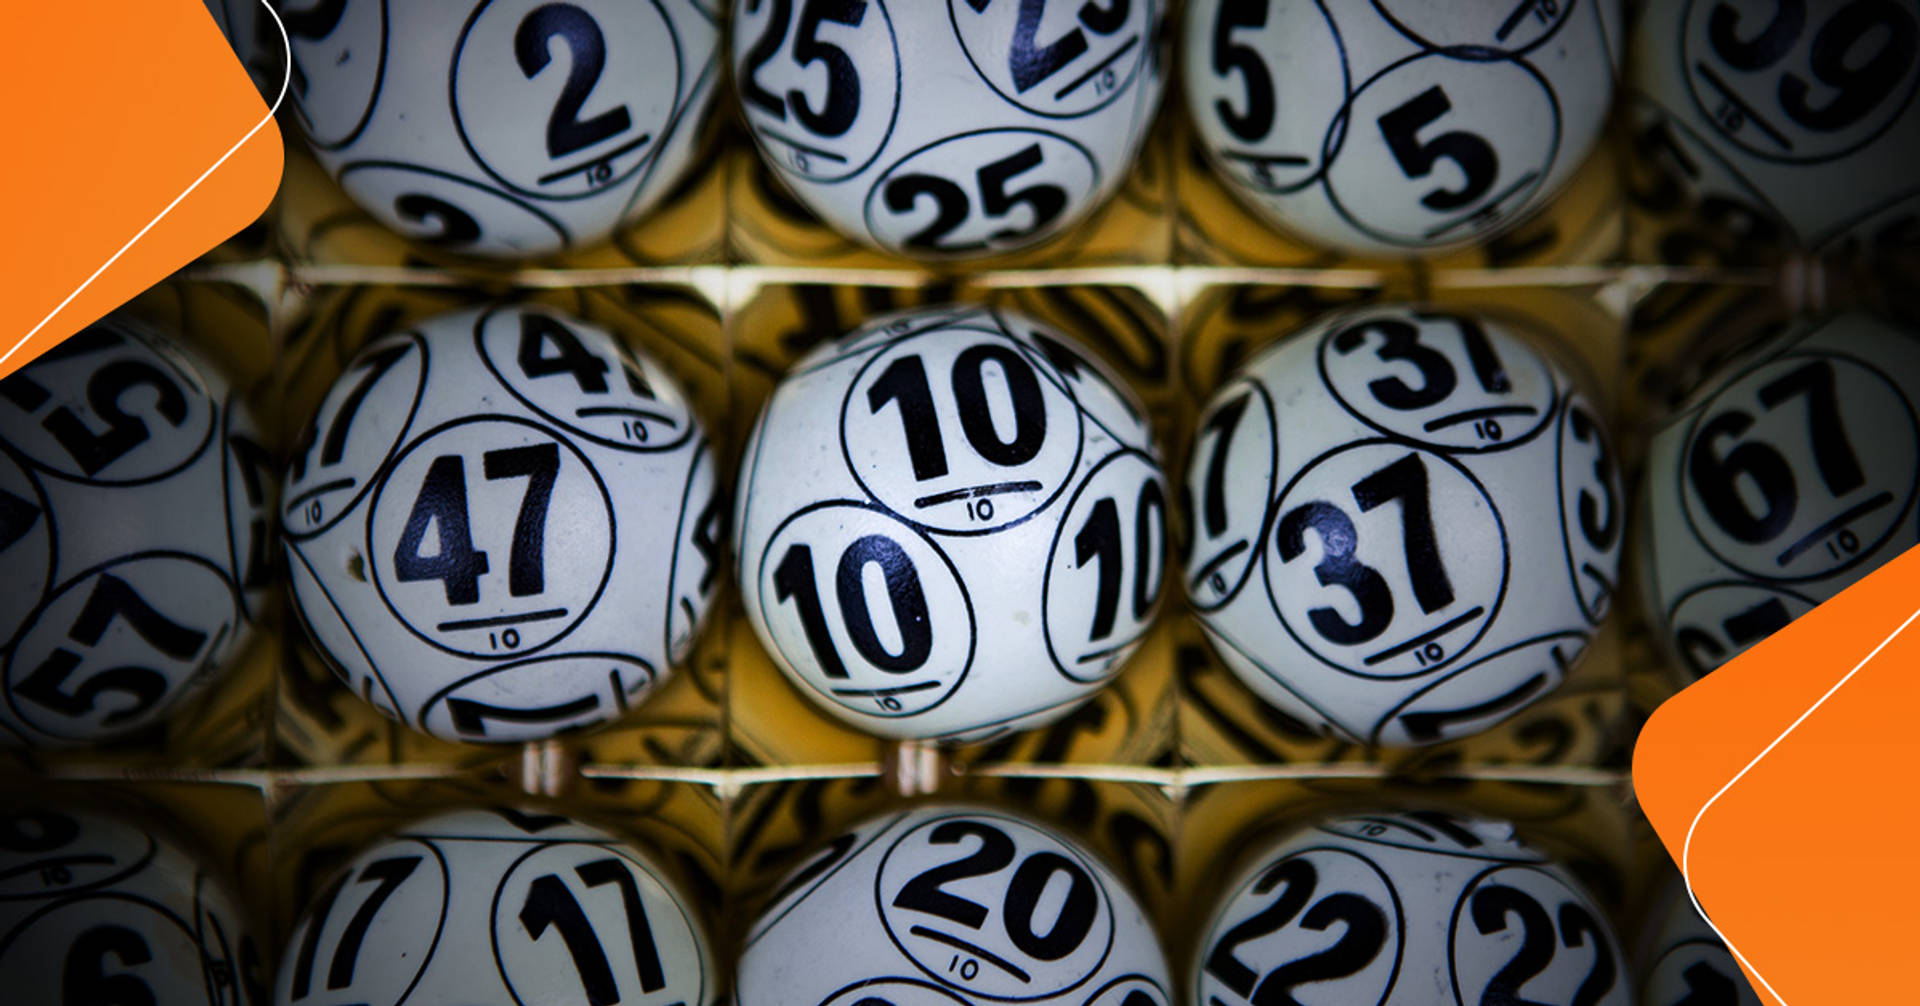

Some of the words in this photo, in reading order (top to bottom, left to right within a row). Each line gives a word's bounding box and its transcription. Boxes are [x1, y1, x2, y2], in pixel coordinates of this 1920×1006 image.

[515, 2, 631, 158] 2
[1215, 0, 1274, 142] 5
[884, 143, 1066, 251] 25
[1377, 86, 1498, 211] 5
[623, 420, 649, 442] 10
[867, 345, 1046, 481] 10
[1475, 420, 1502, 441] 10
[1690, 360, 1866, 543] 67
[394, 443, 560, 605] 47
[967, 498, 994, 520] 10
[1277, 452, 1454, 645] 37
[1826, 529, 1860, 561] 10
[12, 573, 207, 726] 57
[490, 629, 520, 650] 10
[774, 533, 933, 680] 10
[1416, 643, 1444, 665] 10
[876, 696, 902, 713] 10
[292, 856, 423, 1002] 17
[519, 858, 665, 1006] 17
[893, 821, 1098, 960] 20
[1206, 858, 1388, 1006] 22
[949, 955, 979, 980] 10
